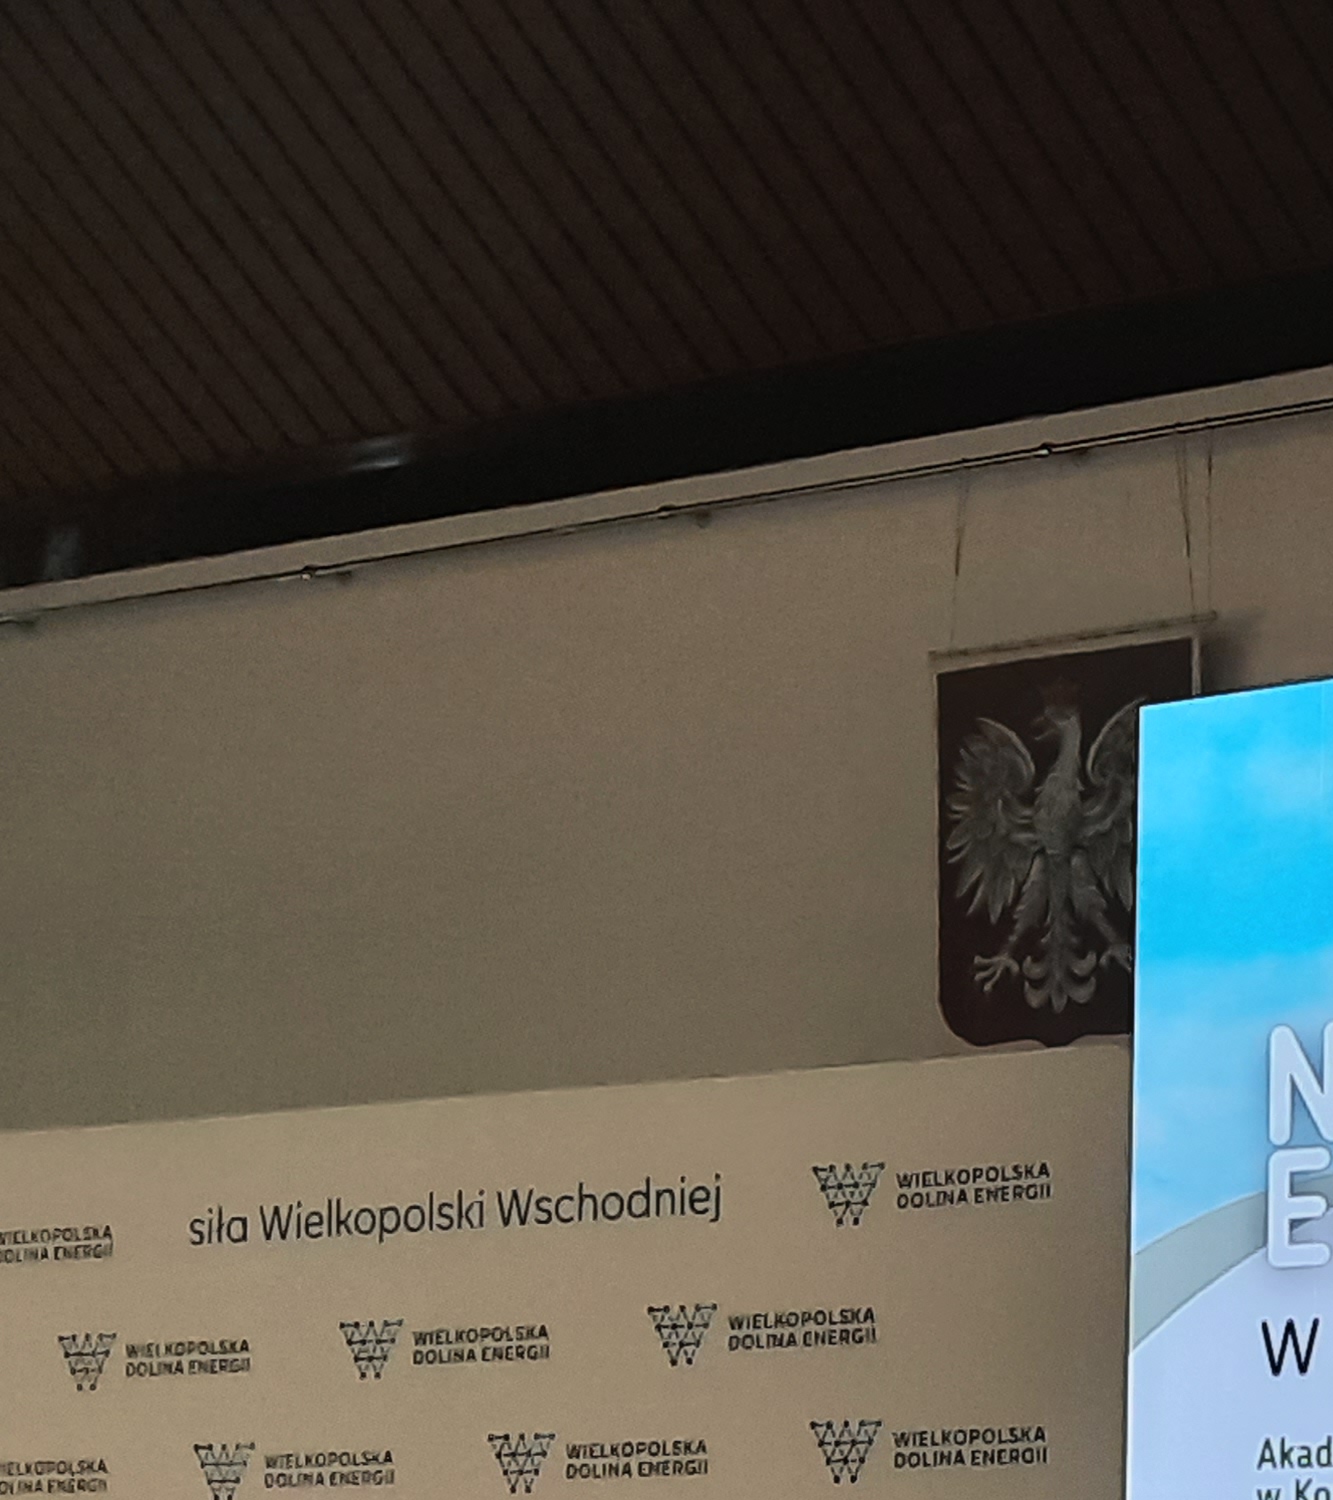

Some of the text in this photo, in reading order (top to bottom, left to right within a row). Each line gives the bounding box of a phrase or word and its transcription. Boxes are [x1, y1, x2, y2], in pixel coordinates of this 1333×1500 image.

[896, 1162, 1050, 1189] WIELKOPOLSKA
[896, 1183, 1051, 1209] DOLINA ENERGII
[189, 1172, 722, 1246] siła Wielkopolski Wschodniej
[0, 1247, 49, 1263] OLINA
[728, 1307, 875, 1331] WIELKOPOLSKA
[412, 1324, 549, 1346] WIELKOPOLSKA
[728, 1328, 877, 1351] DOLINA ENERGII
[413, 1345, 550, 1365] DOLINA ENERGII
[1261, 1316, 1320, 1377] w
[892, 1426, 1046, 1448] WIELKOPOLSKA
[565, 1439, 707, 1459] WIELKOPOLSKA
[894, 1446, 1048, 1468] DOLINA ENERGII
[0, 1459, 109, 1476] IELKOPOLSKA
[565, 1459, 708, 1479] DOLINA ENERGII
[0, 1479, 43, 1495] OLINA
